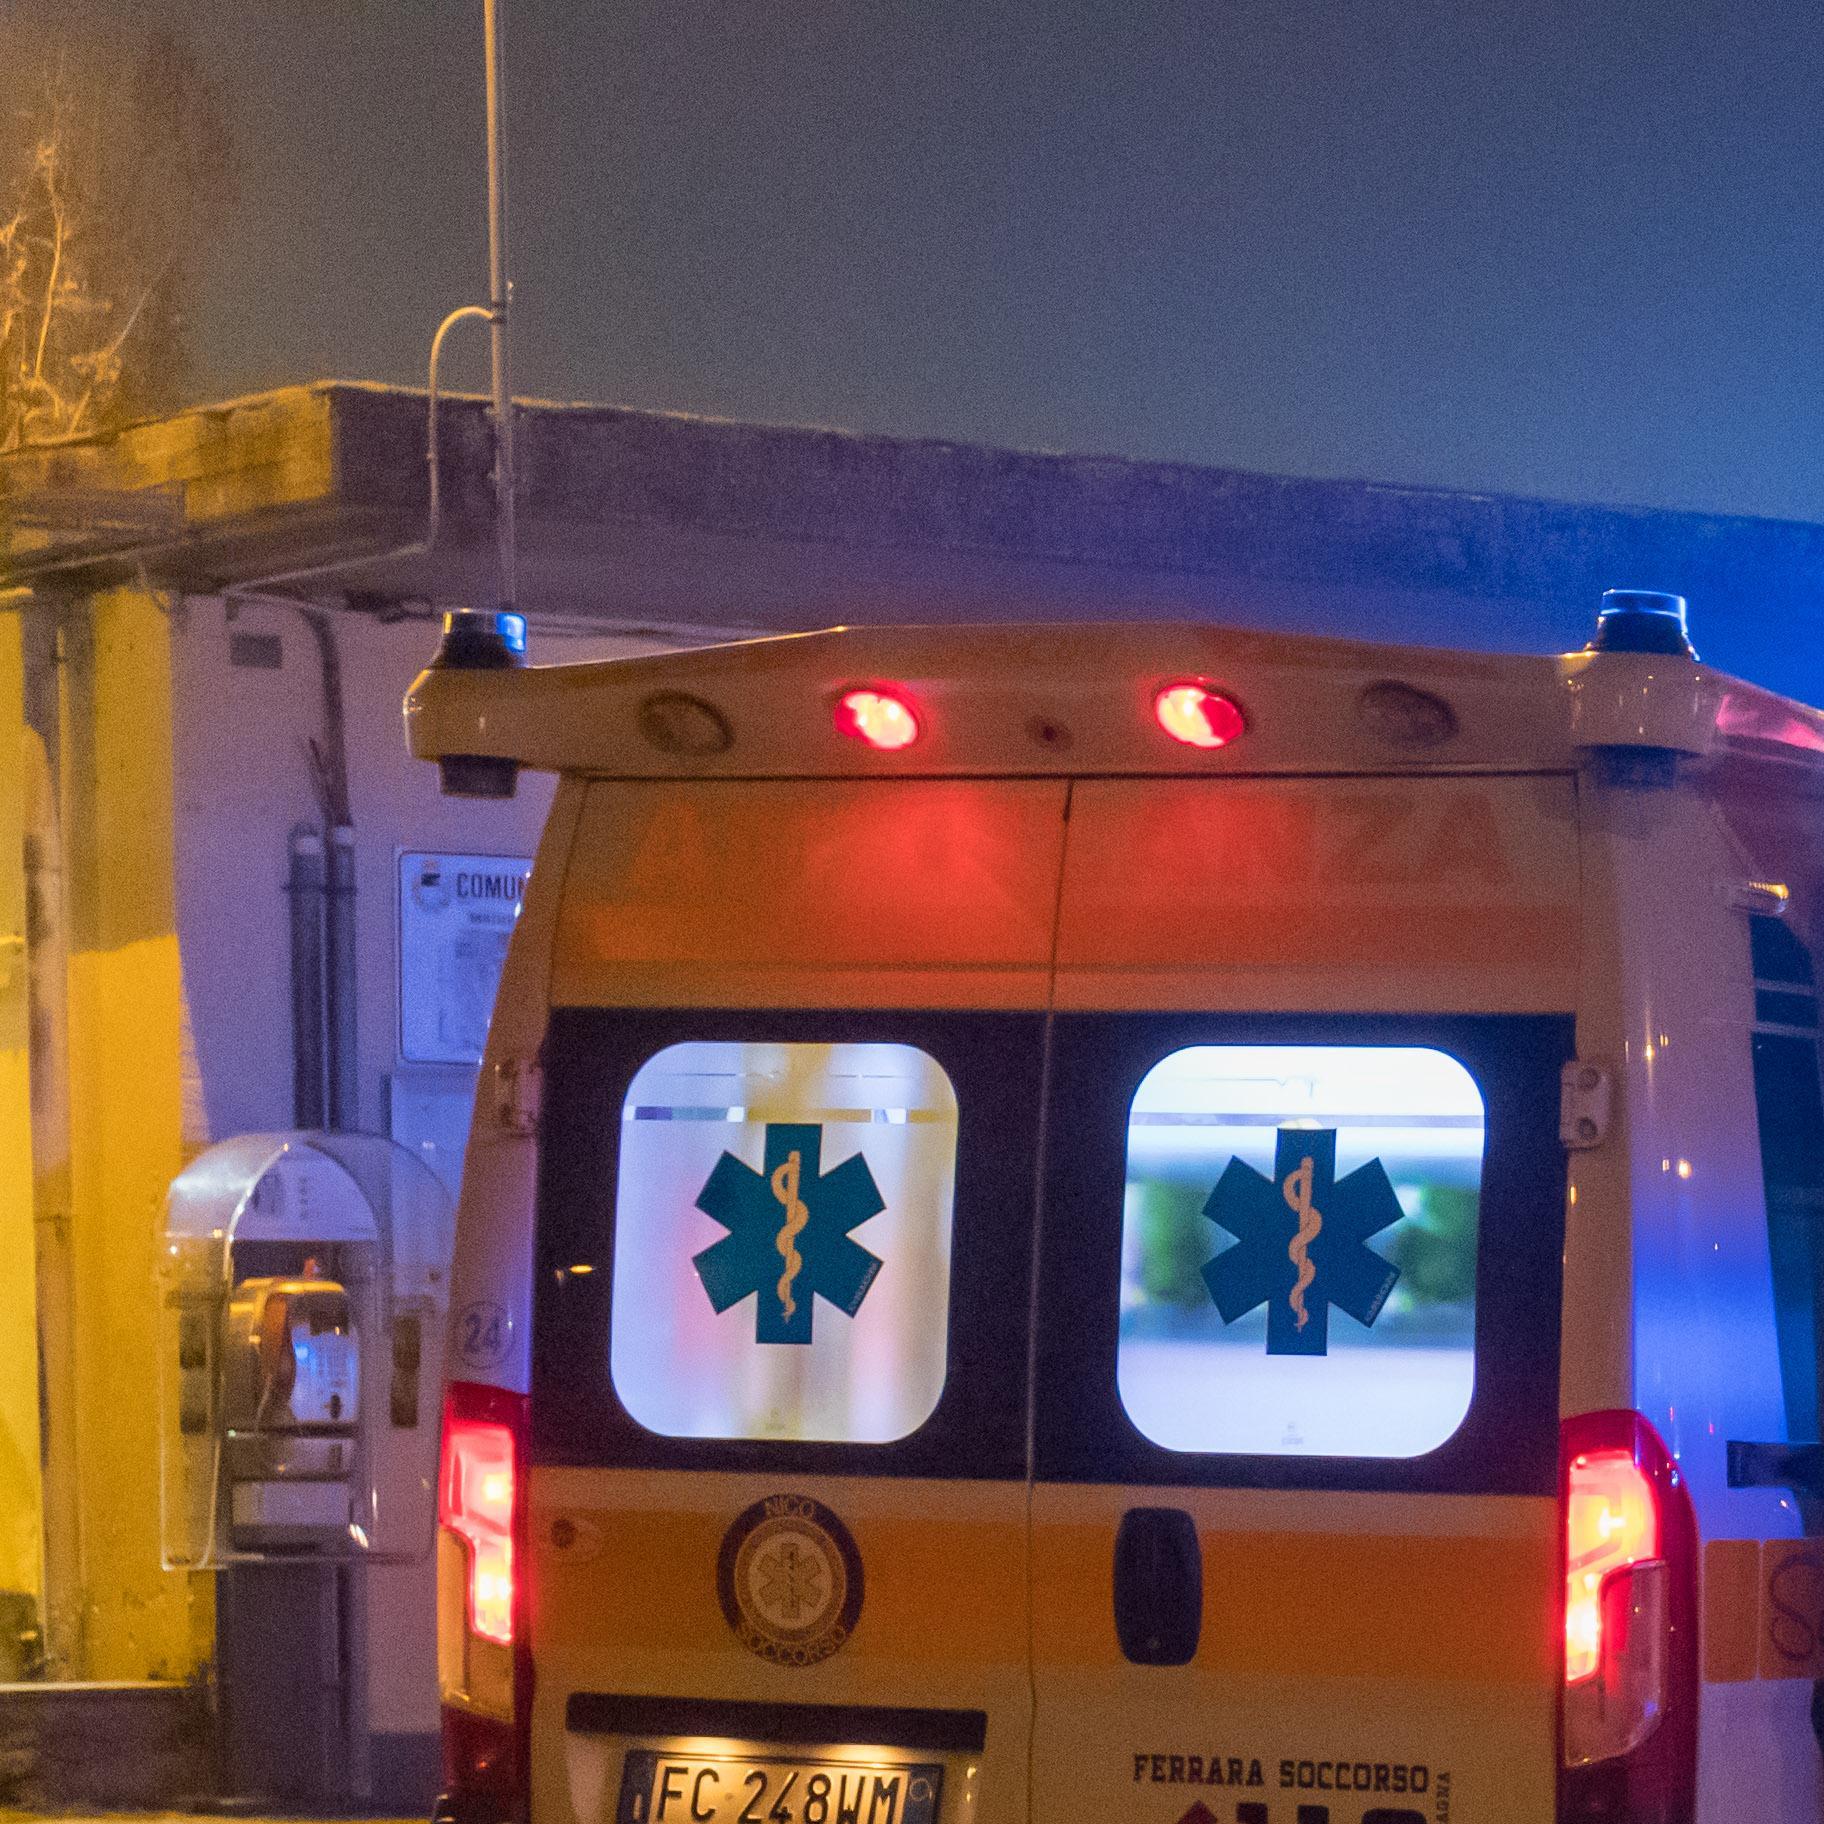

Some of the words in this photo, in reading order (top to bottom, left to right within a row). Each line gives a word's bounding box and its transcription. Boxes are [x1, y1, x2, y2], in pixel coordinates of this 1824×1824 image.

[463, 1312, 501, 1353] 24
[1134, 1754, 1265, 1787] FERRARA
[1279, 1760, 1430, 1793] SOCCORSO
[655, 1765, 720, 1824] FC
